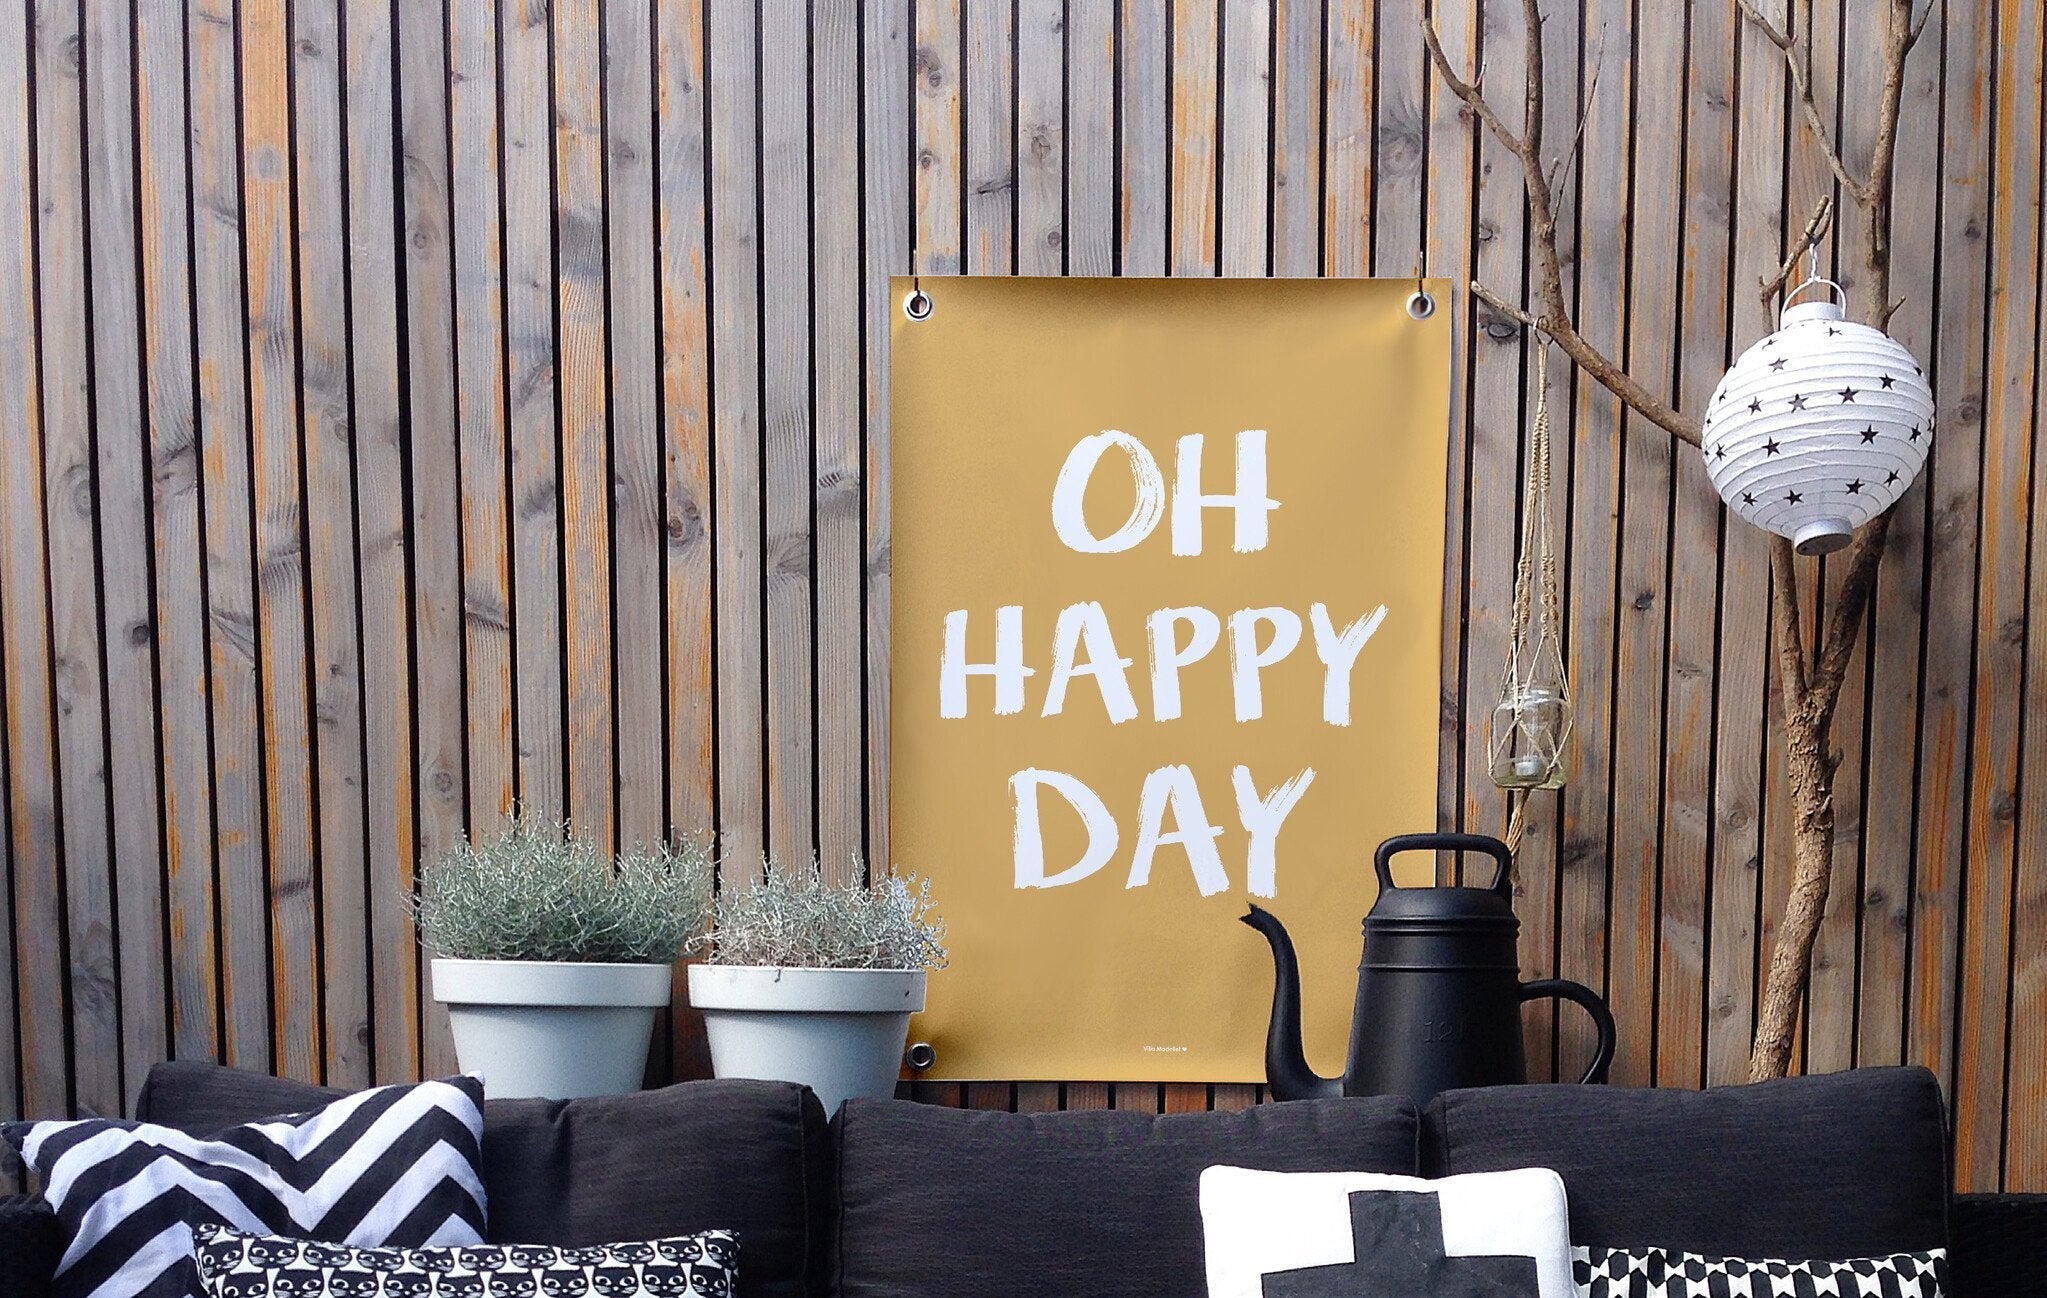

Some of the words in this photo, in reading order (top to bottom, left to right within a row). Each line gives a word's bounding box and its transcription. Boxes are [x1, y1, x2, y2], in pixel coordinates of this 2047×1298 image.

[1052, 430, 1281, 556] OH
[940, 602, 1388, 727] HAPPY
[1009, 764, 1316, 898] DAY
